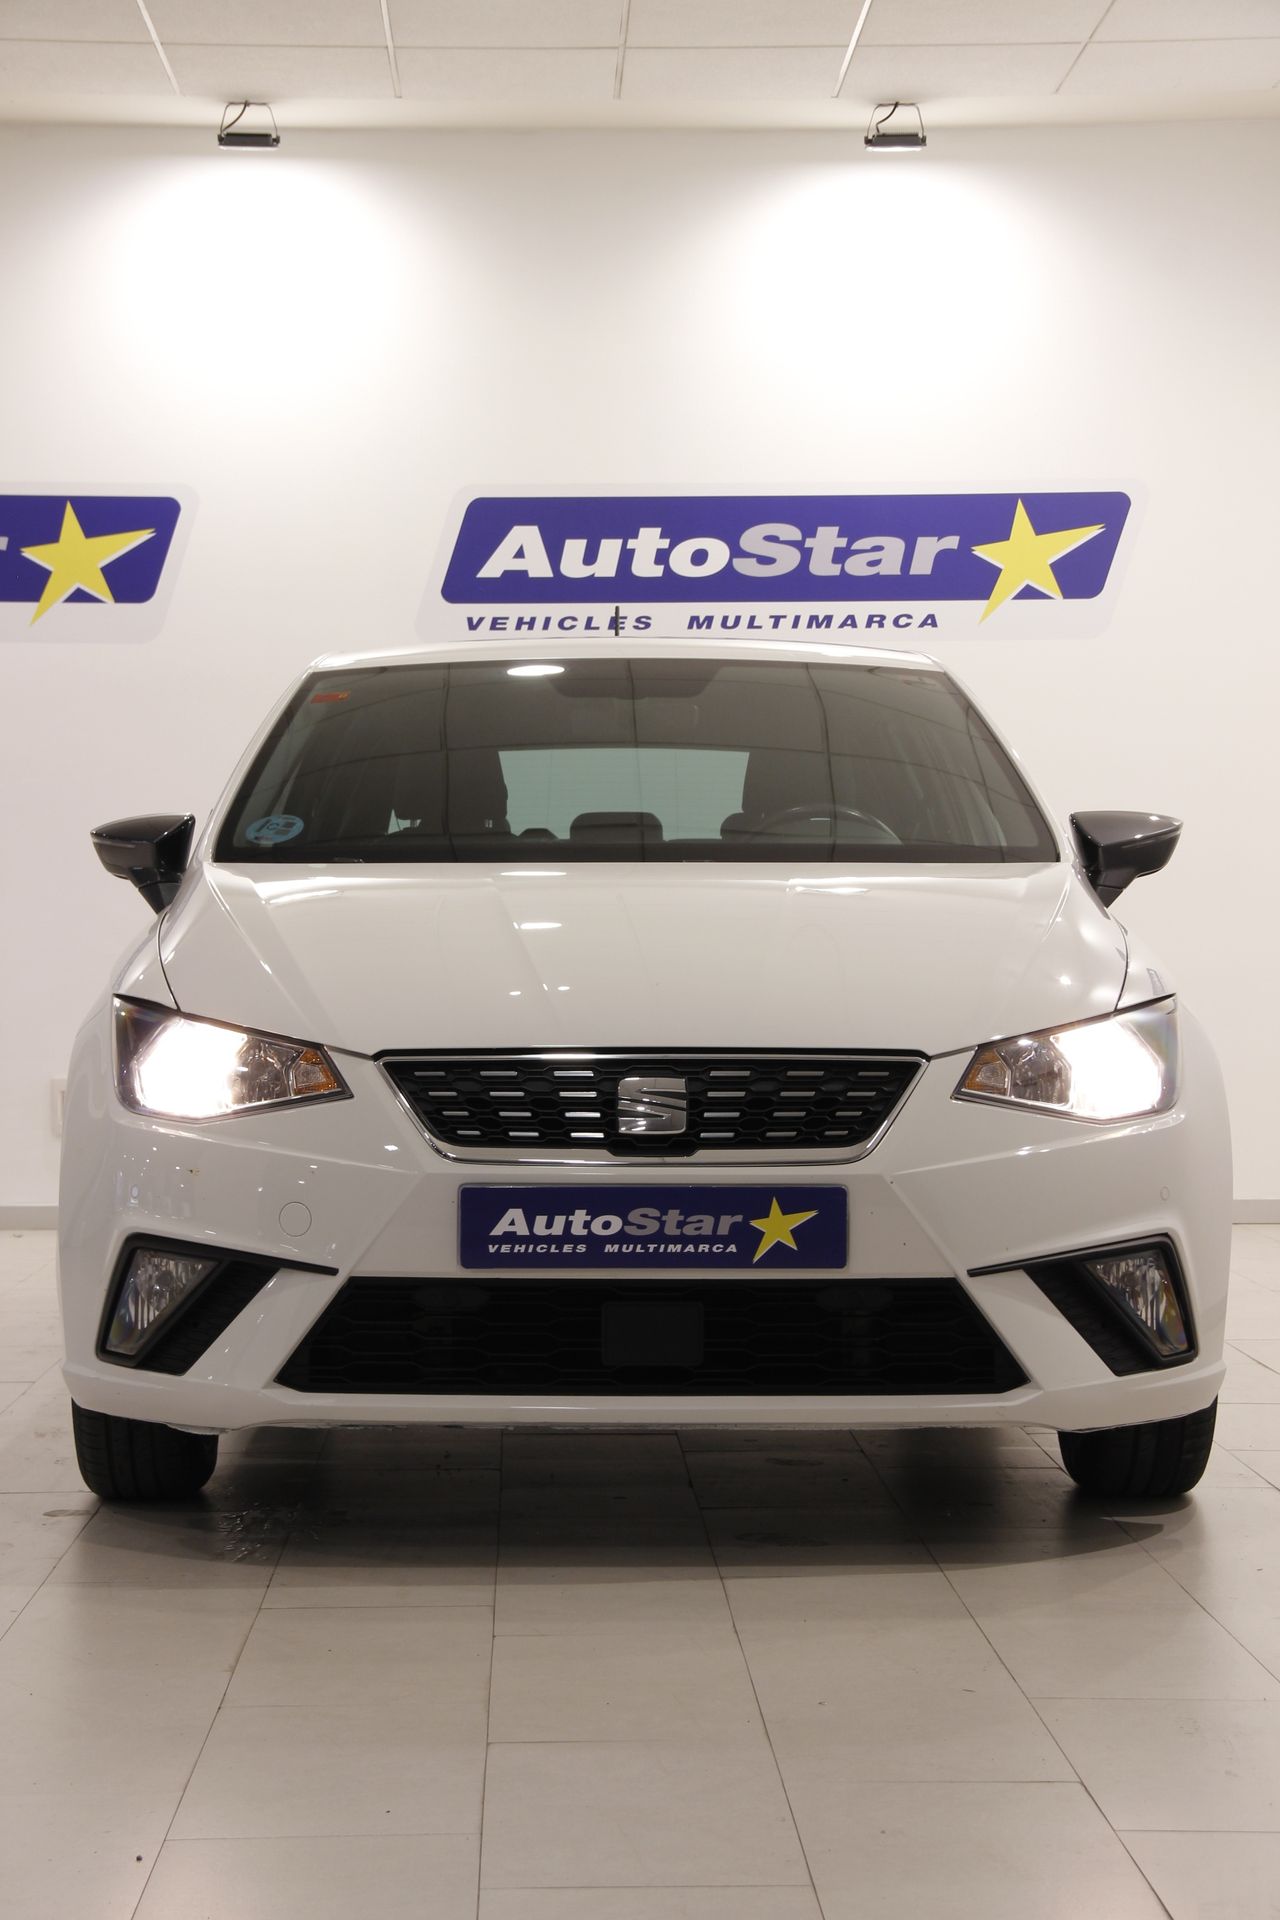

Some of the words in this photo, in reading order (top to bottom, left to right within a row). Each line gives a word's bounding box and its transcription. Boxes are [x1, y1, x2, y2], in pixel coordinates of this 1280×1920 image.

[475, 522, 961, 579] AutoStar
[466, 615, 652, 631] VEHICLES
[687, 613, 938, 630] MULTIMARCA
[488, 1206, 744, 1237] AutoStar
[487, 1243, 588, 1254] VEHICLES
[603, 1243, 738, 1254] MULTIMARCA
